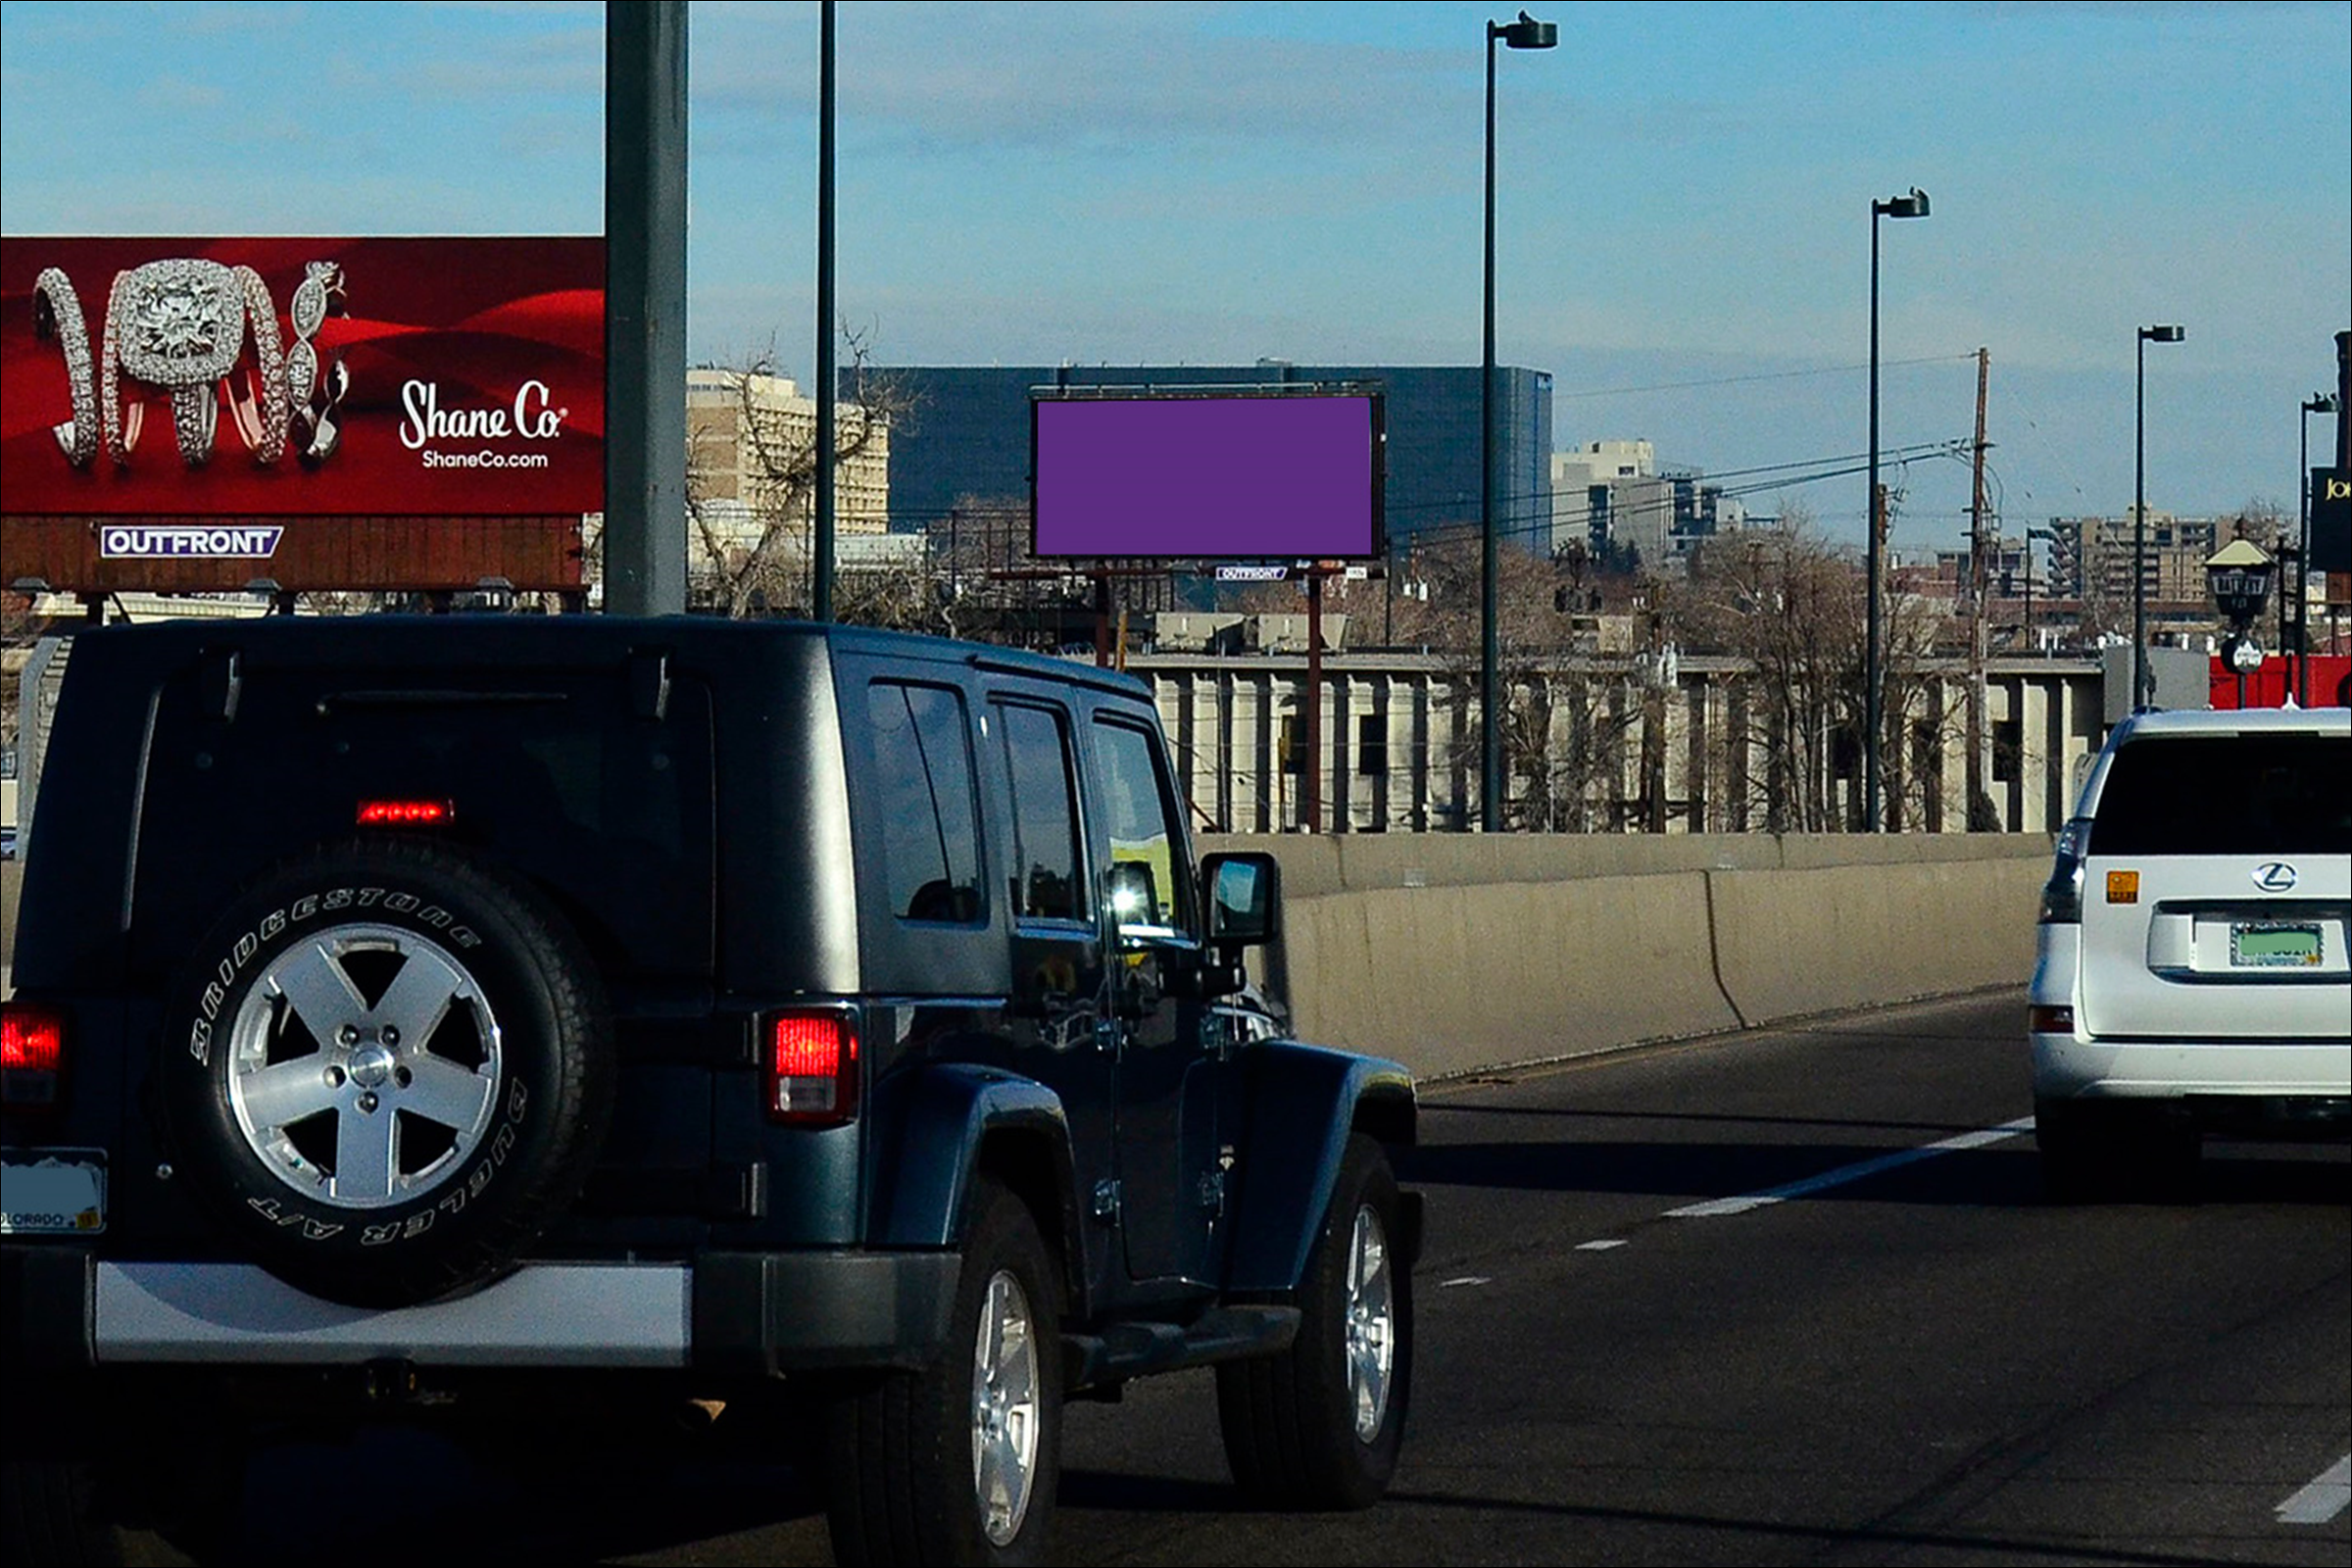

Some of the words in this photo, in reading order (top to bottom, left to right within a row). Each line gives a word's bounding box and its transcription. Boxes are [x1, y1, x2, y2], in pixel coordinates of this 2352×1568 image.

[400, 380, 512, 449] Shane
[422, 450, 549, 467] ShaneCo.com
[108, 530, 272, 554] OUTFRONT
[190, 887, 482, 1066] BRIDGESTONE
[361, 1077, 528, 1246] DUELER
[247, 1198, 344, 1241] A/T
